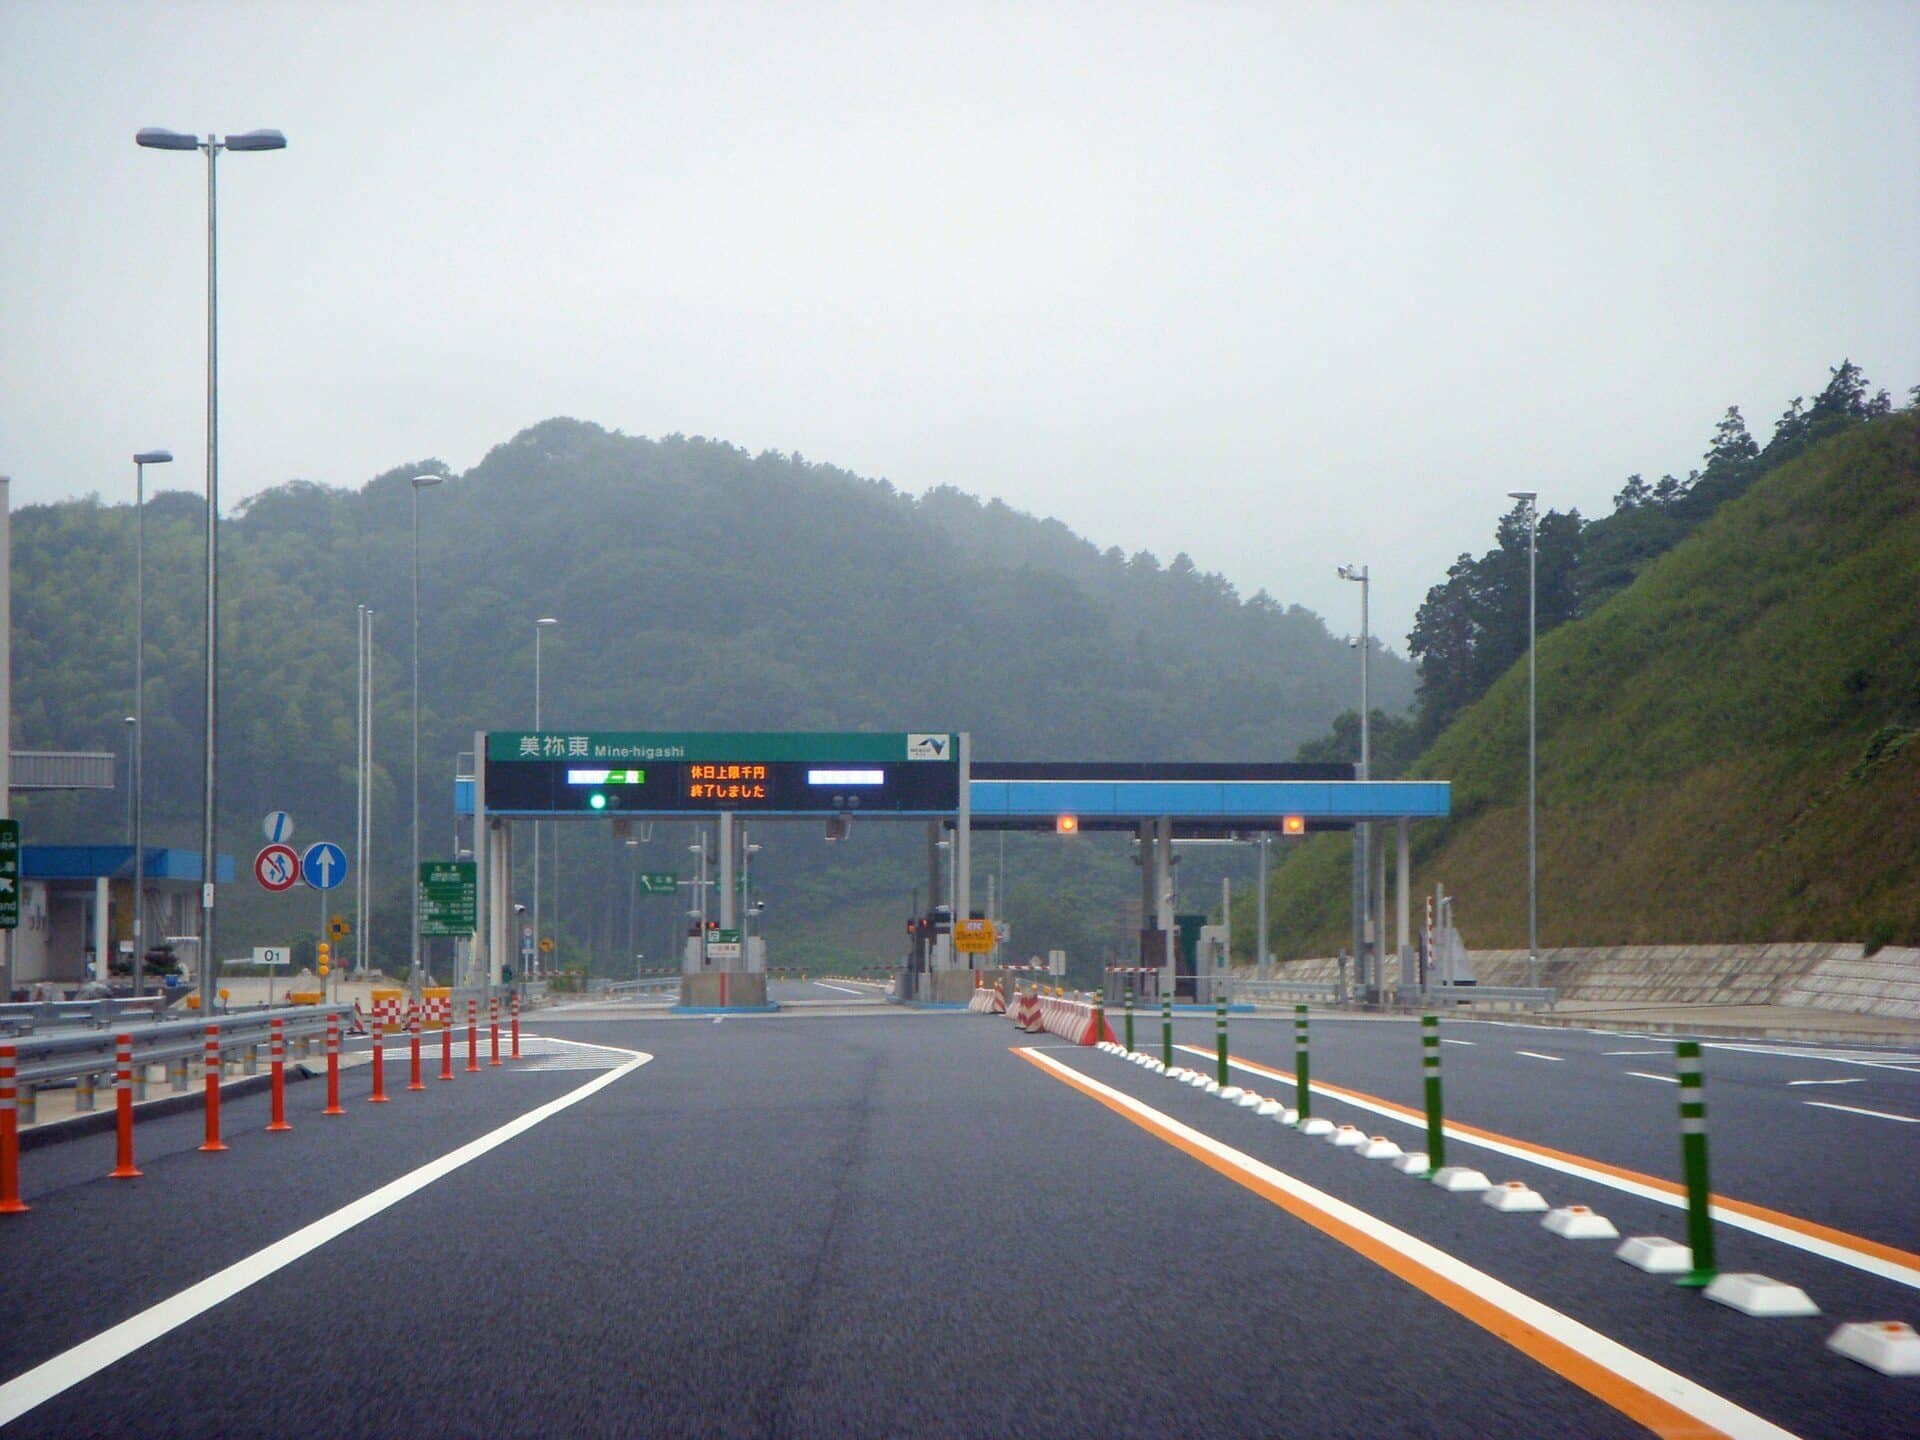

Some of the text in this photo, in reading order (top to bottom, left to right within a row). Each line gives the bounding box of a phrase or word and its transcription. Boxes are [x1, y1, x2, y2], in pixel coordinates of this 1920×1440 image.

[519, 736, 684, 759] 美祢東 Mine-higashi
[691, 766, 765, 779] 休日上限千円
[690, 785, 765, 798] 終了しました
